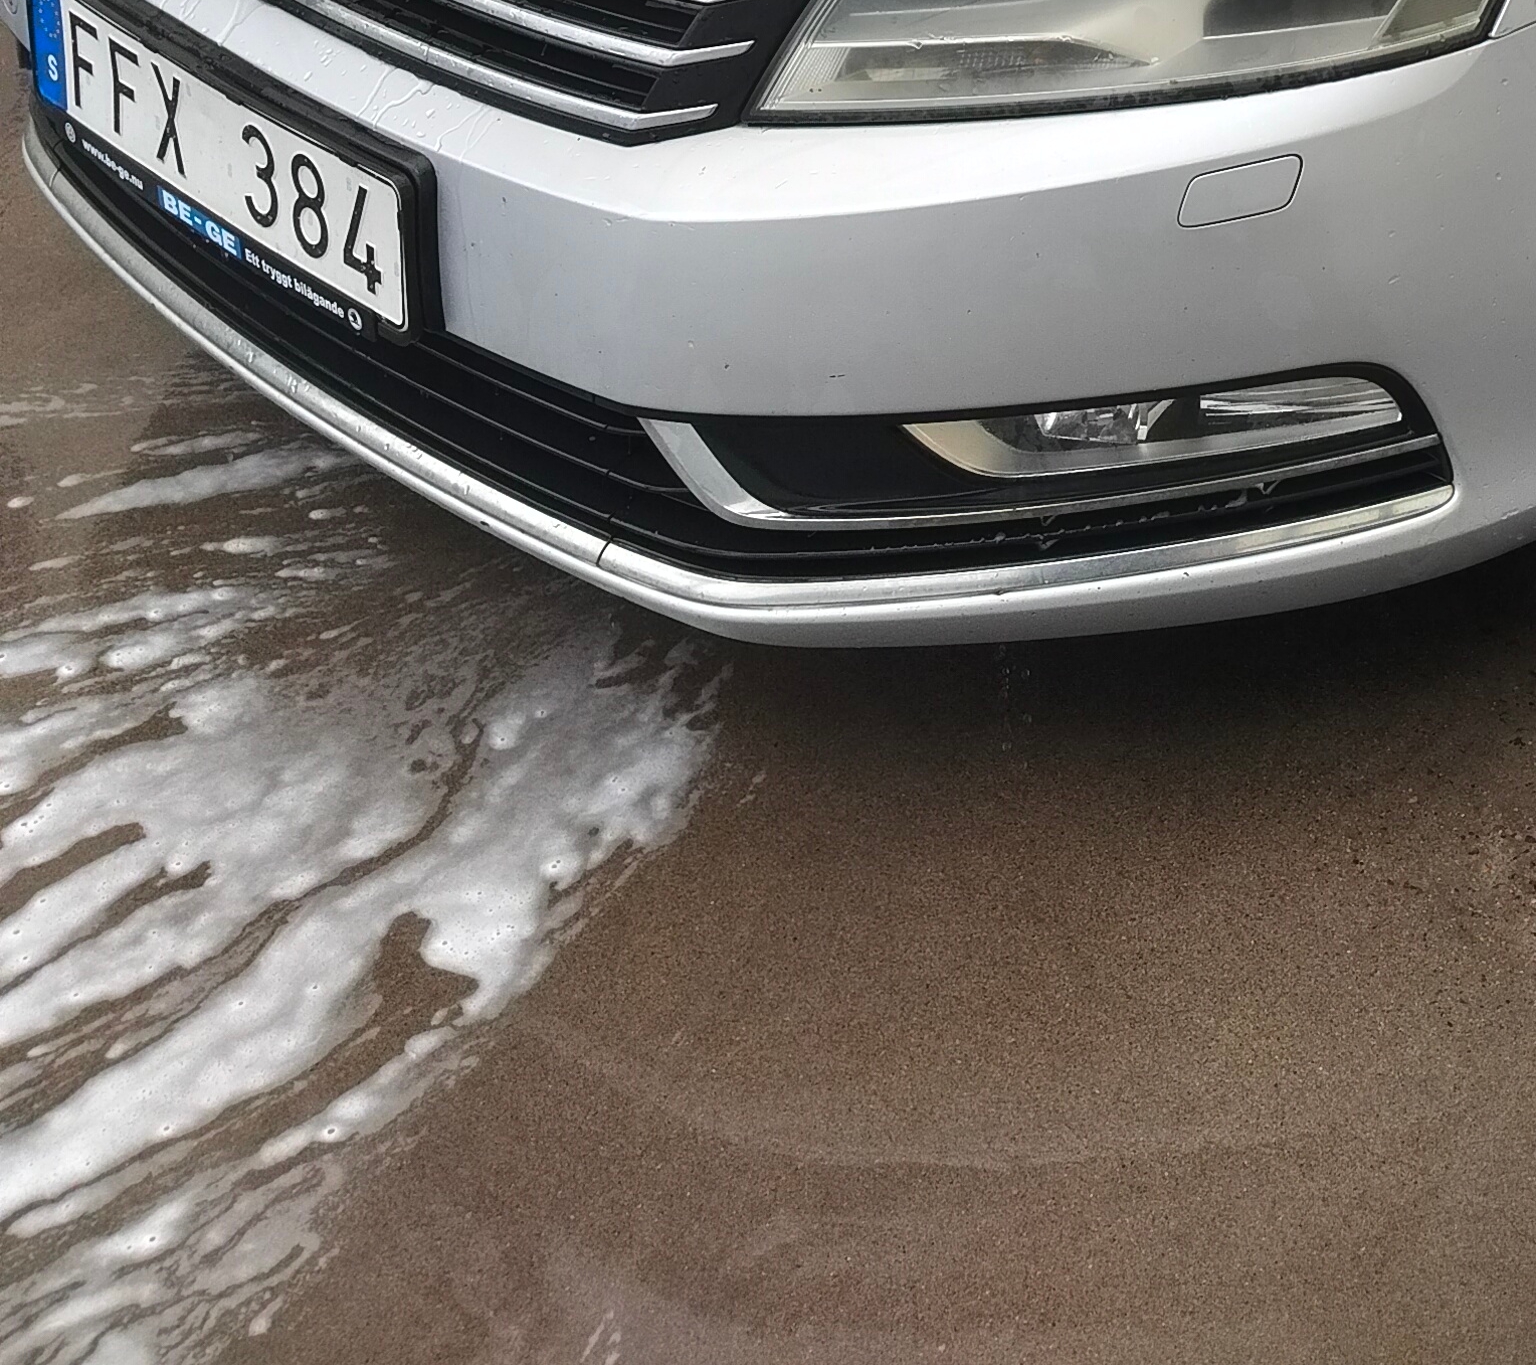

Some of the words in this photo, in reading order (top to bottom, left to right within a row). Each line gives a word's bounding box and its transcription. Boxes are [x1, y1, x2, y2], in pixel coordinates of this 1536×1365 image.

[46, 53, 59, 82] S
[68, 10, 186, 178] FFX
[241, 124, 383, 296] 384
[81, 138, 144, 191] www.be-ge.nu
[244, 247, 261, 269] Ett
[261, 259, 293, 289] tryggt
[293, 277, 345, 319] bilägande
